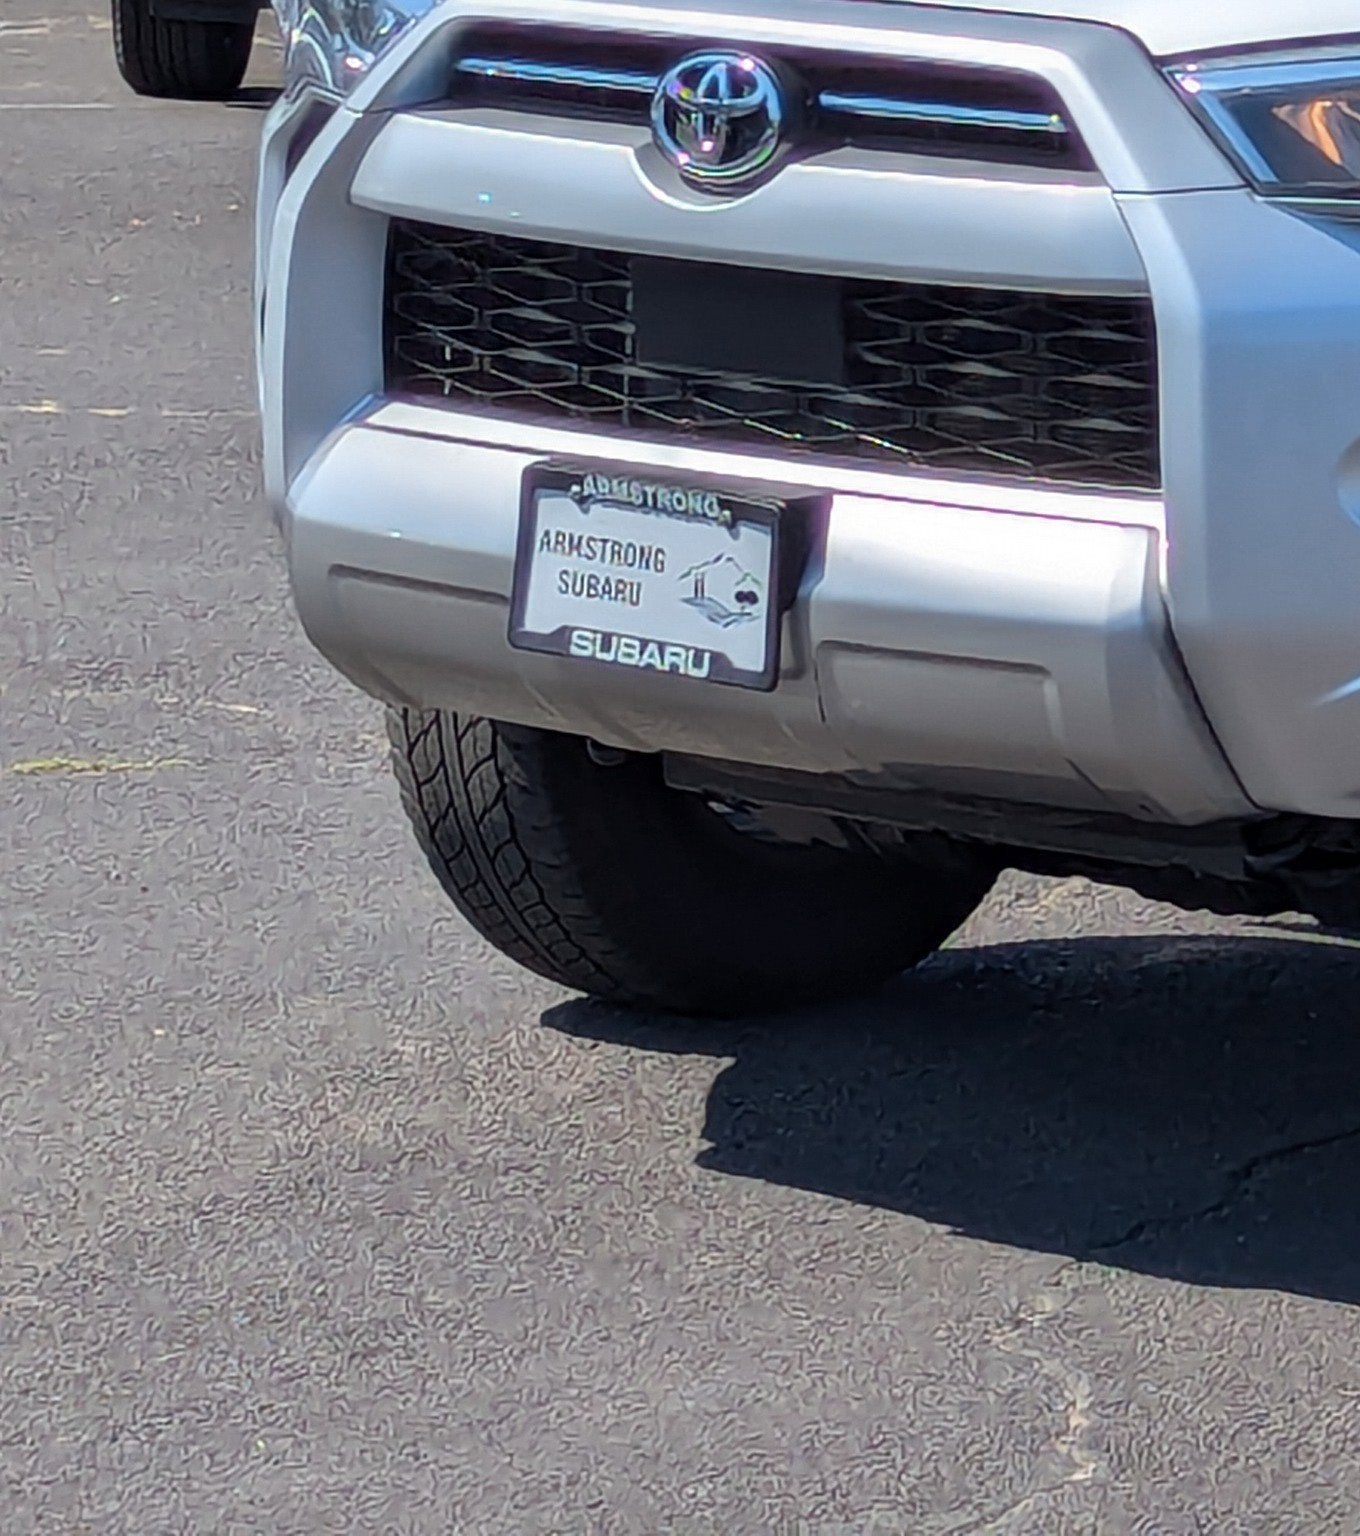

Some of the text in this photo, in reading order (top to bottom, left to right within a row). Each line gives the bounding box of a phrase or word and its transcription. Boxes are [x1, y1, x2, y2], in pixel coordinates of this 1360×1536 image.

[581, 473, 720, 517] ARMSTRONG
[539, 528, 666, 573] ARMSTRONG
[558, 569, 642, 607] SUBARU
[569, 630, 712, 678] SUBARU
